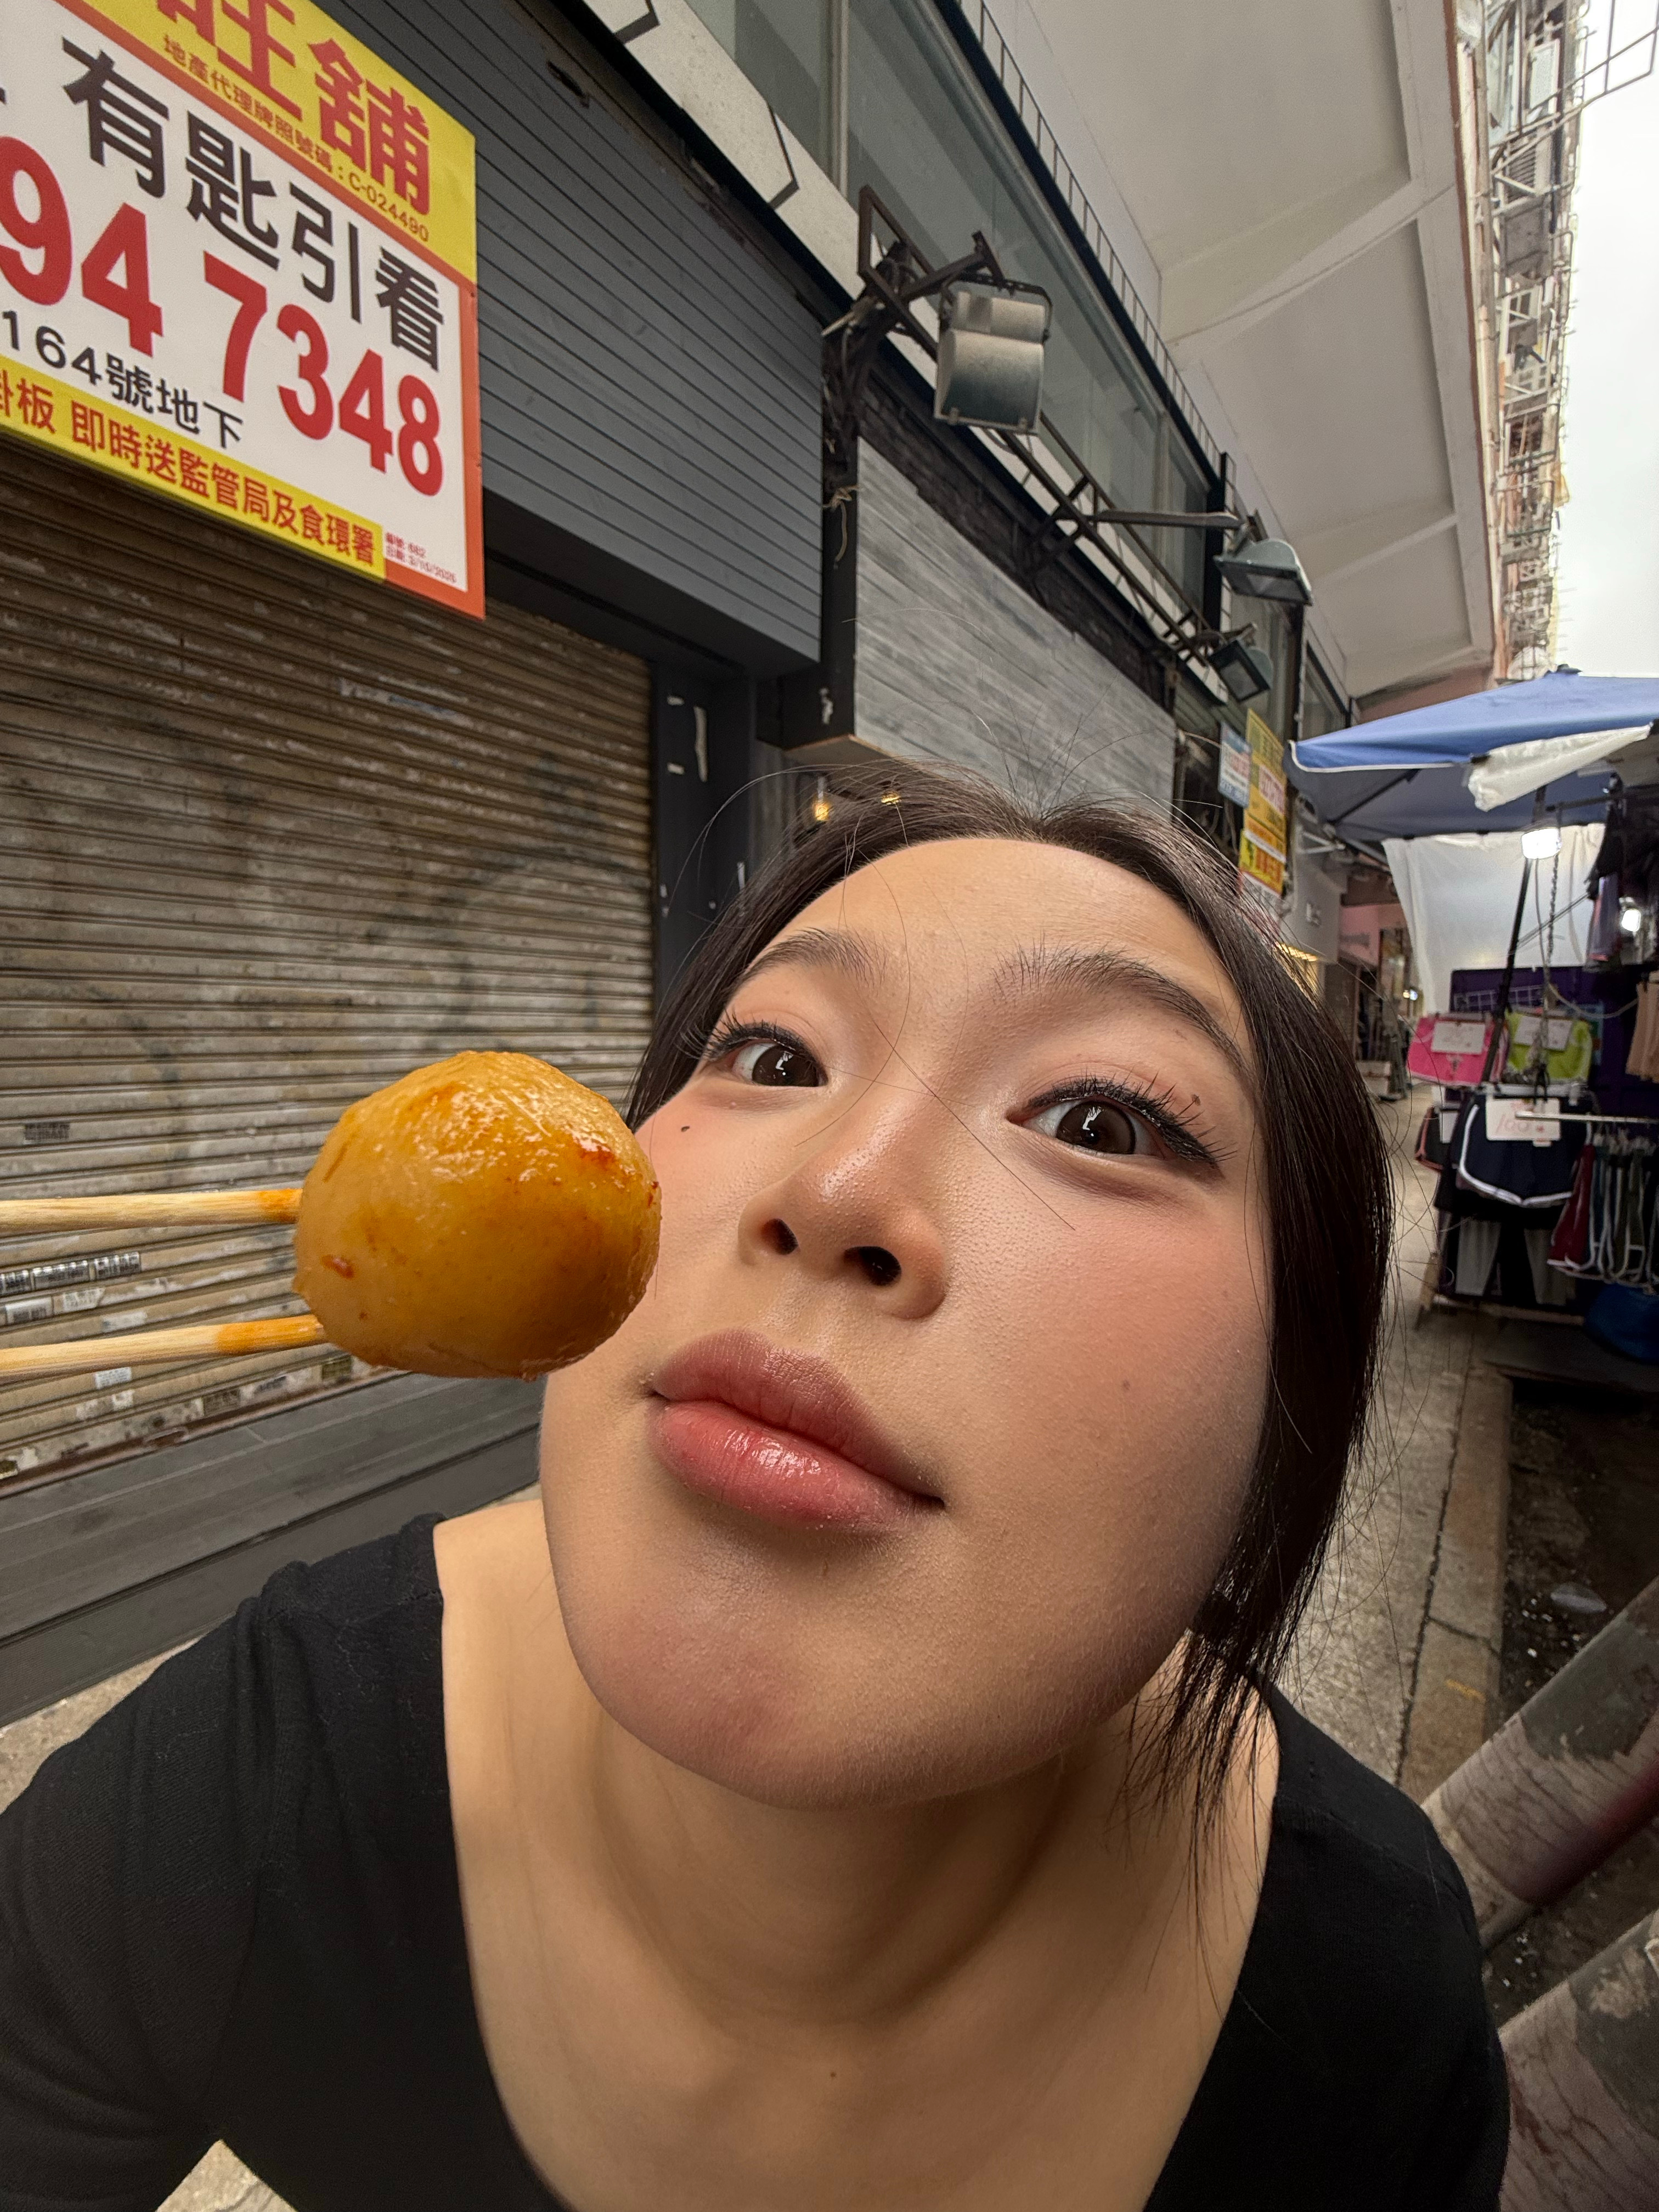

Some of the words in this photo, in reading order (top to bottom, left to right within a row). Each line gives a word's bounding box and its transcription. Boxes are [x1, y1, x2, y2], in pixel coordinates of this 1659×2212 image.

[0, 136, 163, 358] 94
[204, 251, 443, 496] 7348
[71, 399, 375, 566] 即時送監管局及食環署
